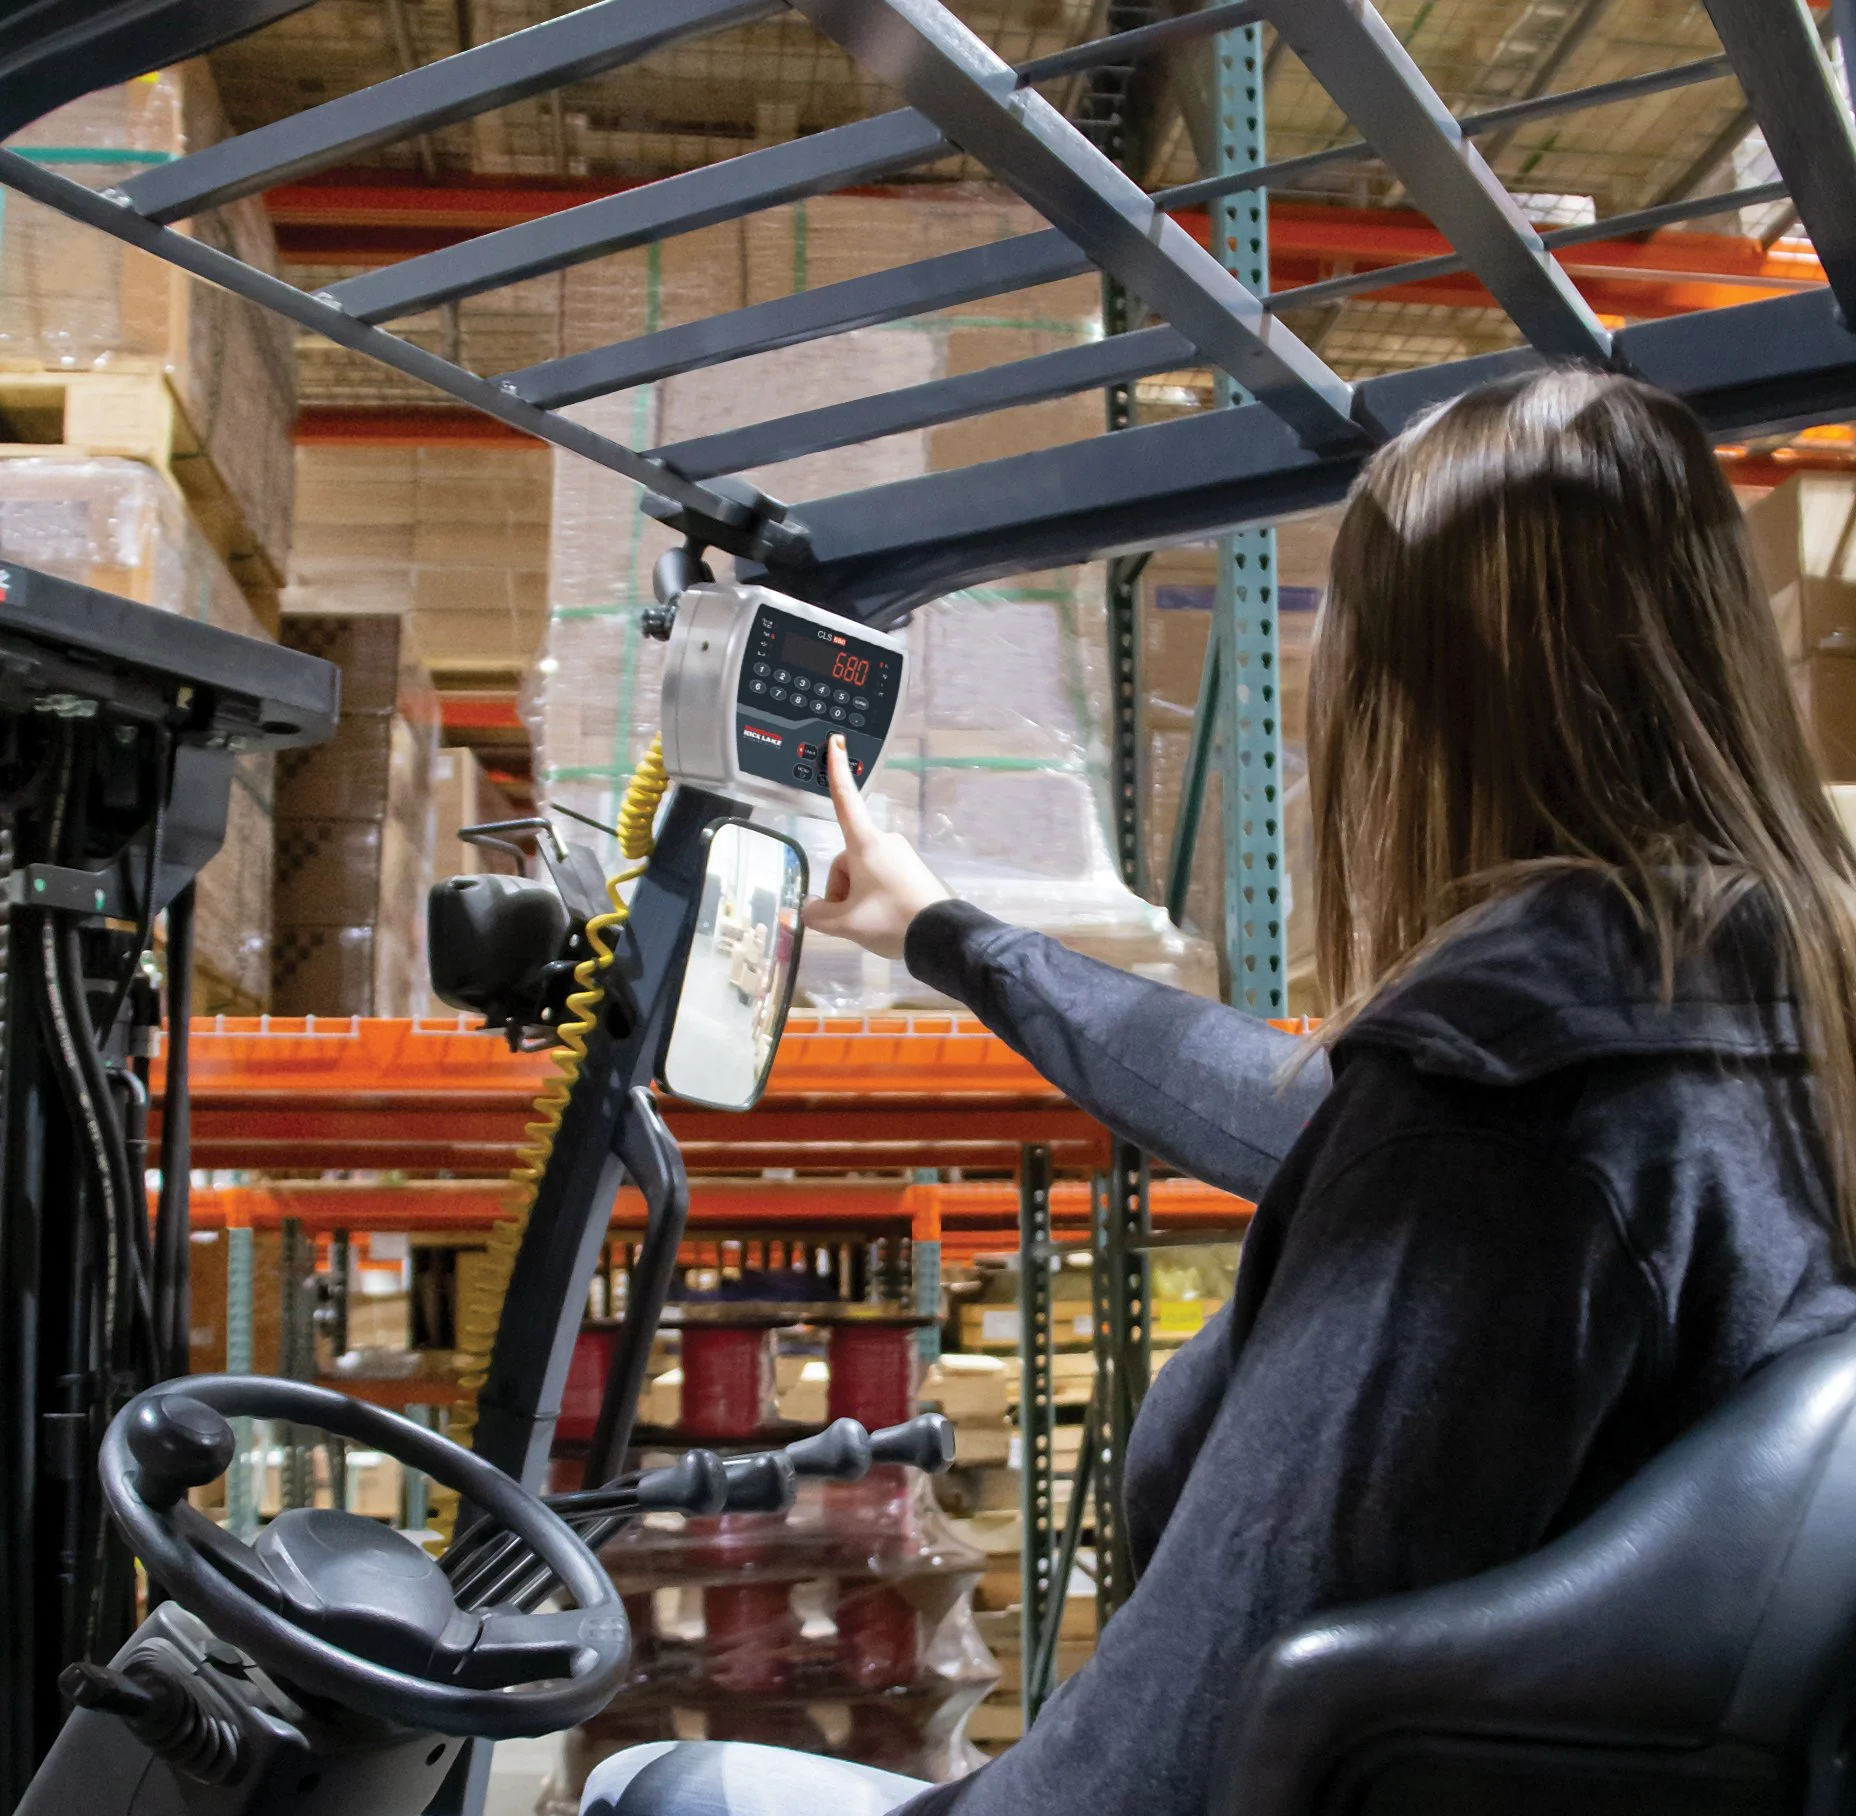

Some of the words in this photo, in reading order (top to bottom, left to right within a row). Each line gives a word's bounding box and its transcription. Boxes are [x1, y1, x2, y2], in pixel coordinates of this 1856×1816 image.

[817, 630, 833, 642] CLS
[832, 652, 869, 686] 680
[761, 735, 783, 746] LAKE
